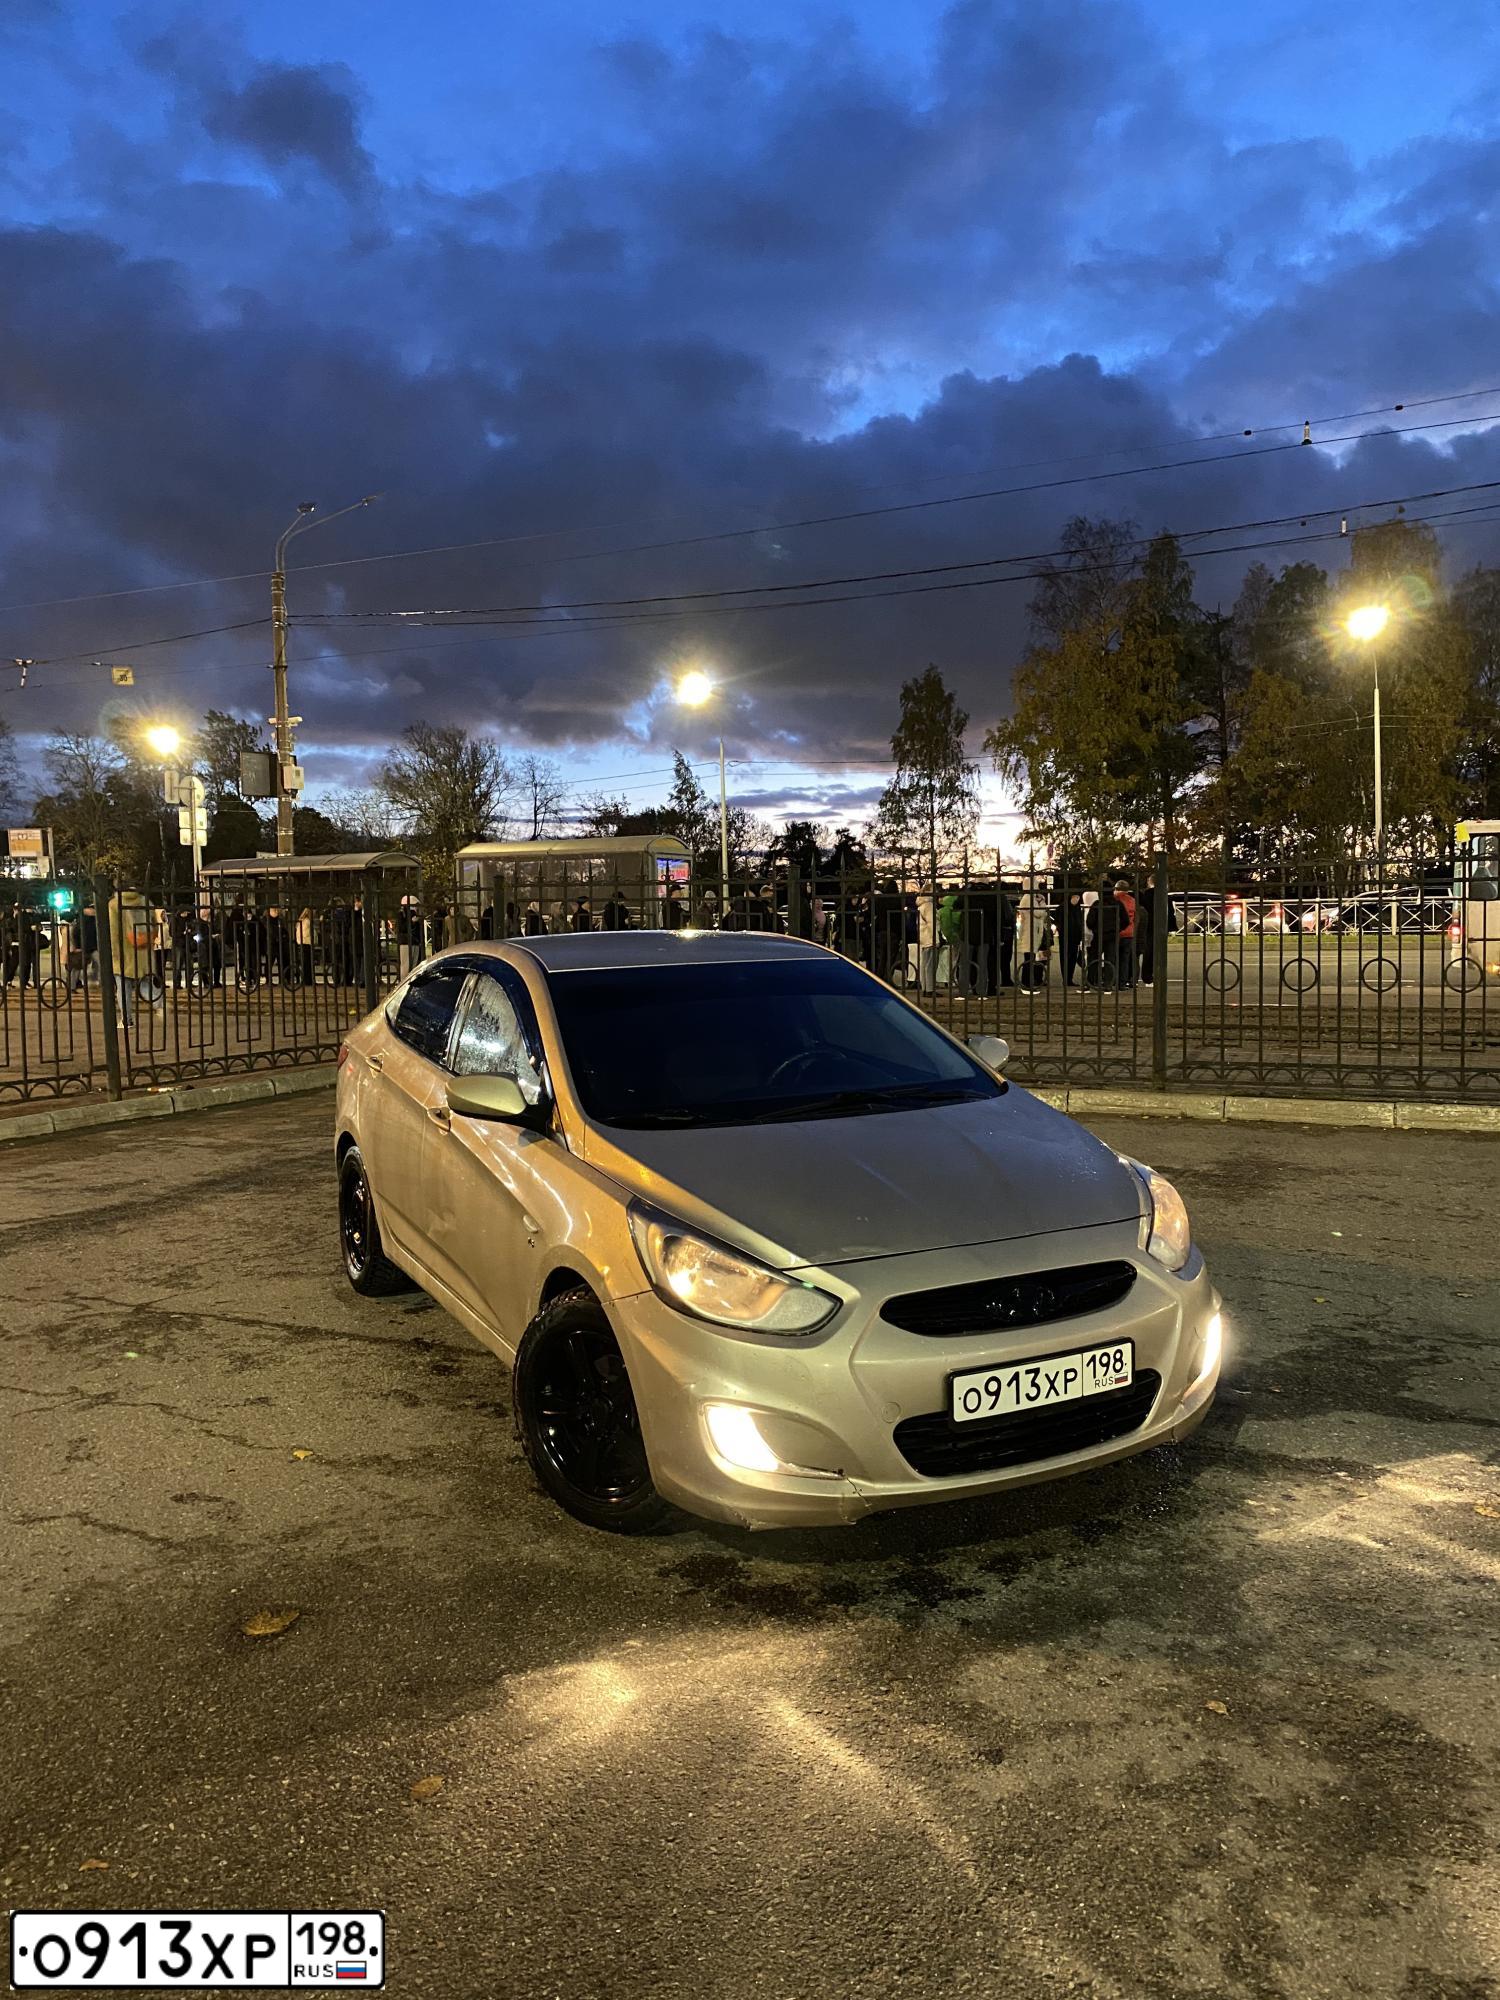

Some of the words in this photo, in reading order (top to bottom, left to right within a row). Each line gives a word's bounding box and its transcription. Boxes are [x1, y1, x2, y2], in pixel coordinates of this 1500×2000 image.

[1086, 1349, 1124, 1379] 198
[963, 1367, 1078, 1413] О913ХР
[1094, 1376, 1114, 1388] RUS
